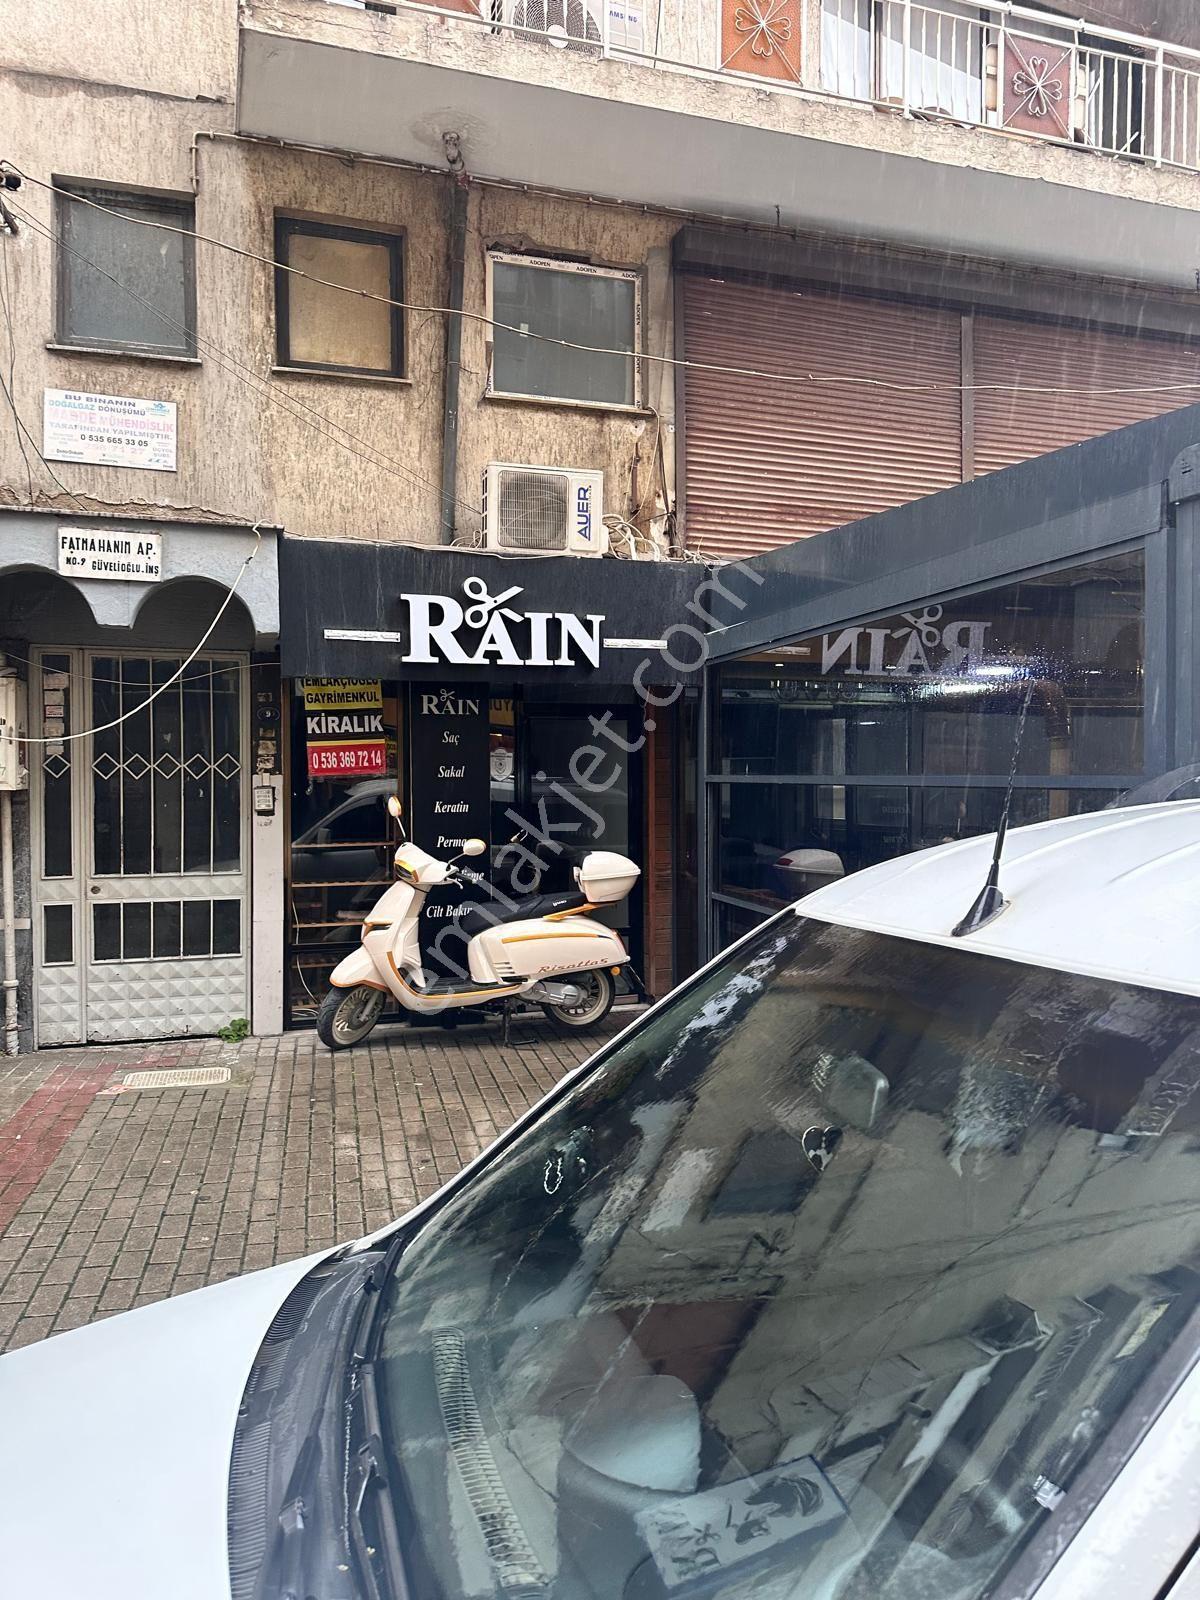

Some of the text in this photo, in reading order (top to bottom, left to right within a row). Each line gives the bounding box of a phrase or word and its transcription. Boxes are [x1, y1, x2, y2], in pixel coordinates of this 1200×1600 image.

[608, 10, 638, 22] AMSNG
[529, 259, 551, 267] ADOPEN
[576, 265, 597, 274] ADOPEN
[88, 434, 105, 443] 535
[106, 436, 123, 445] 665
[125, 438, 136, 446] 33
[137, 439, 149, 447] 05
[577, 486, 591, 542] AUER
[400, 593, 606, 668] RAIN
[306, 690, 380, 704] GAYRİMENKUL
[420, 693, 480, 715] RAIN
[306, 712, 384, 734] KİRALIK
[442, 730, 460, 745] Saç
[312, 750, 382, 769] 0 536 369 72 14
[437, 765, 465, 778] Sakal
[434, 800, 469, 813] Keratin
[426, 905, 444, 918] Cilt
